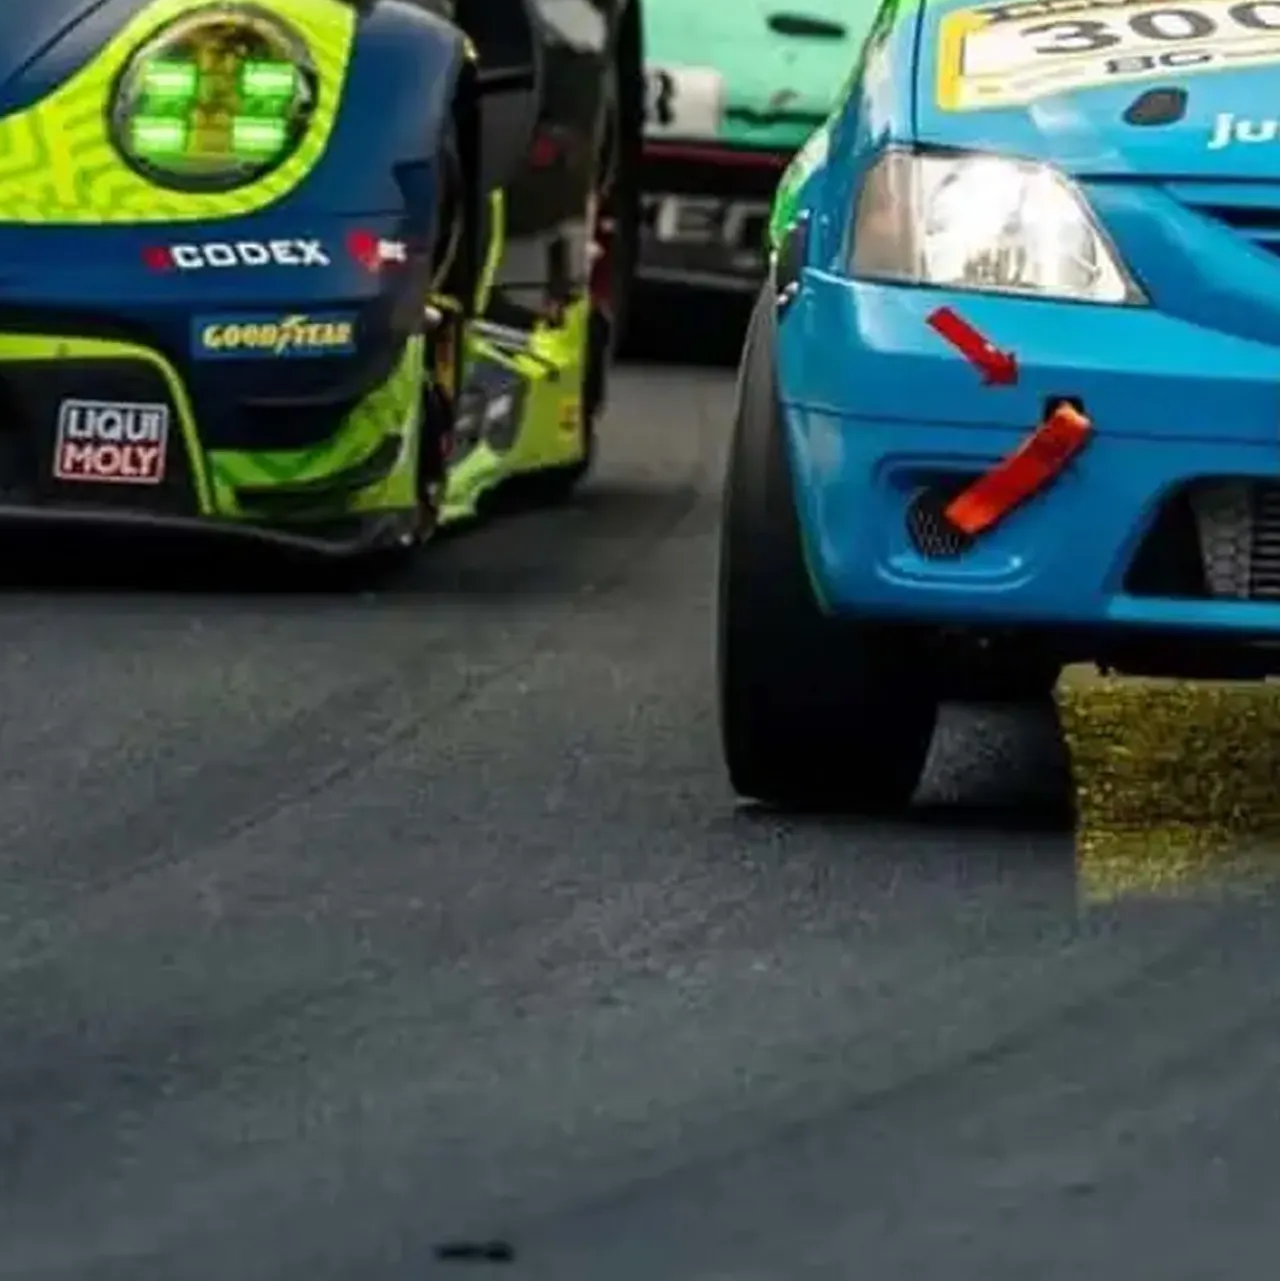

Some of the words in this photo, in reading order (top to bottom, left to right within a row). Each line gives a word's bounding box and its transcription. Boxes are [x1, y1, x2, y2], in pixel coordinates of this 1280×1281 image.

[169, 238, 332, 269] CODEX
[201, 314, 352, 357] GOODYEAR
[67, 406, 161, 442] LIQUI
[61, 441, 160, 477] MOLY
